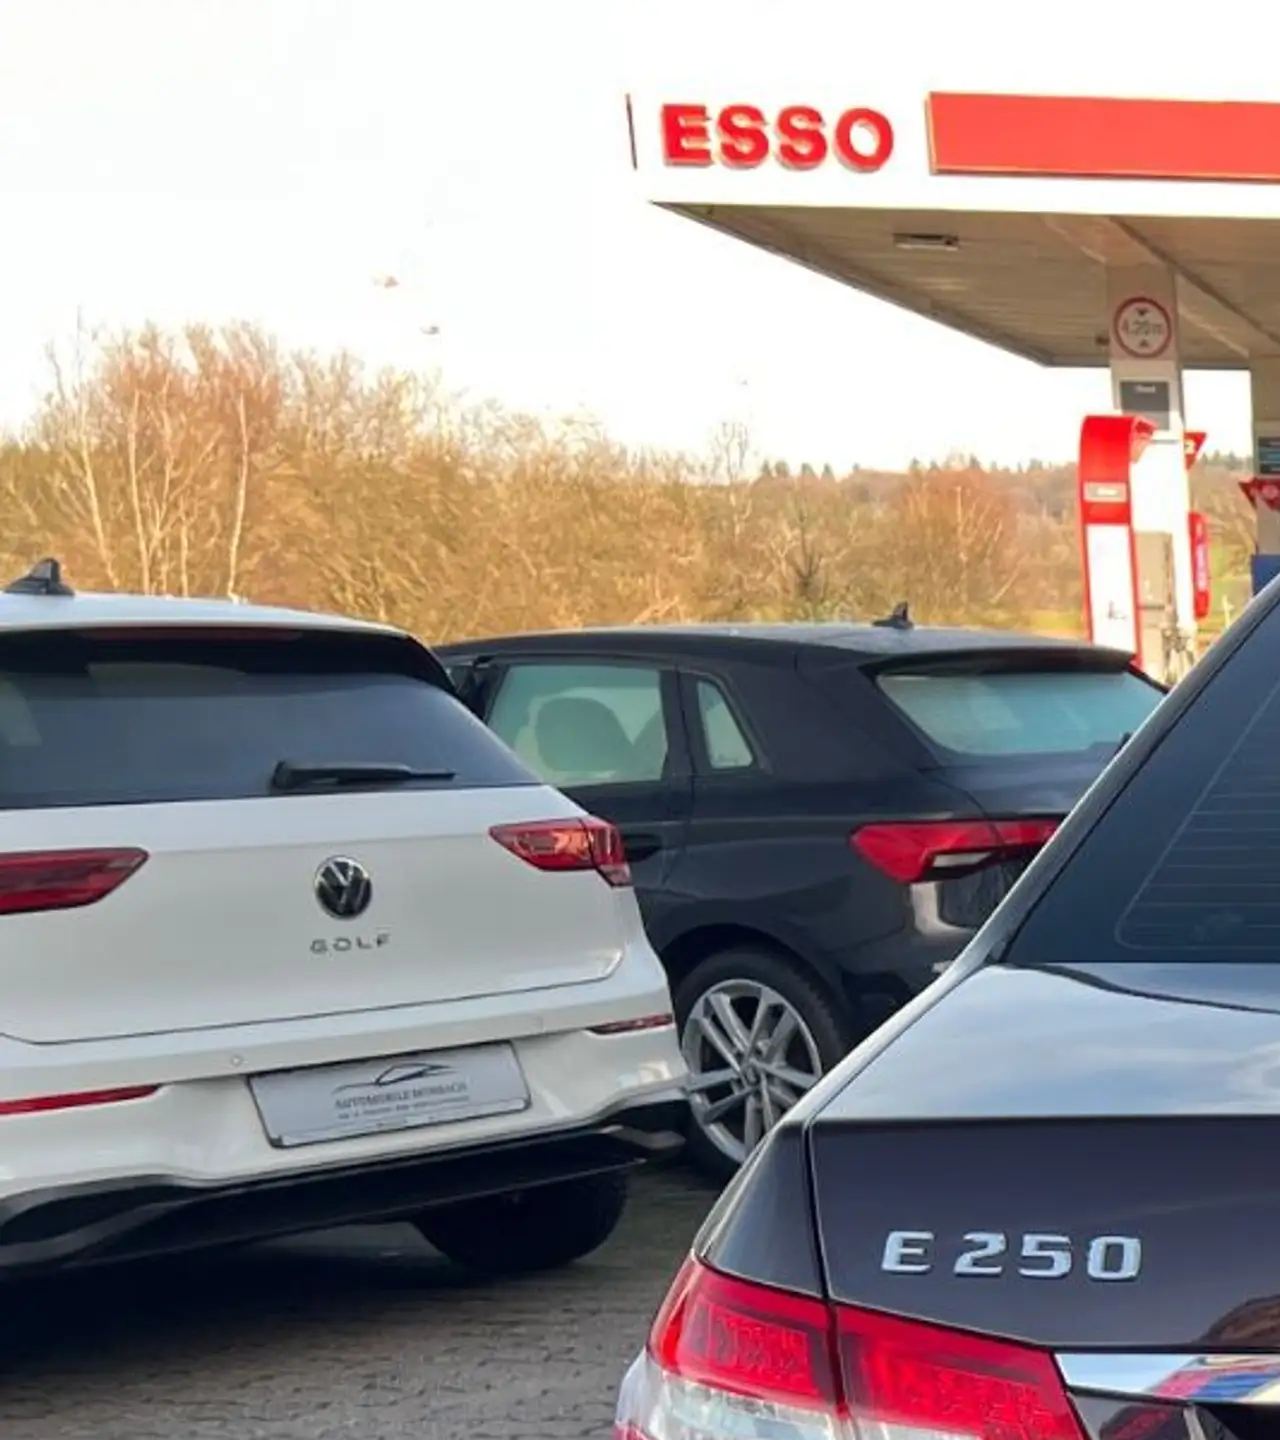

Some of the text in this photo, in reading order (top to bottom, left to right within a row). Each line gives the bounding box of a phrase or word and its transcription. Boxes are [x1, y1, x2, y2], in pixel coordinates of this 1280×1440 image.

[661, 103, 895, 174] ESSO
[310, 932, 391, 955] GOLF
[881, 1231, 1142, 1280] E 250
